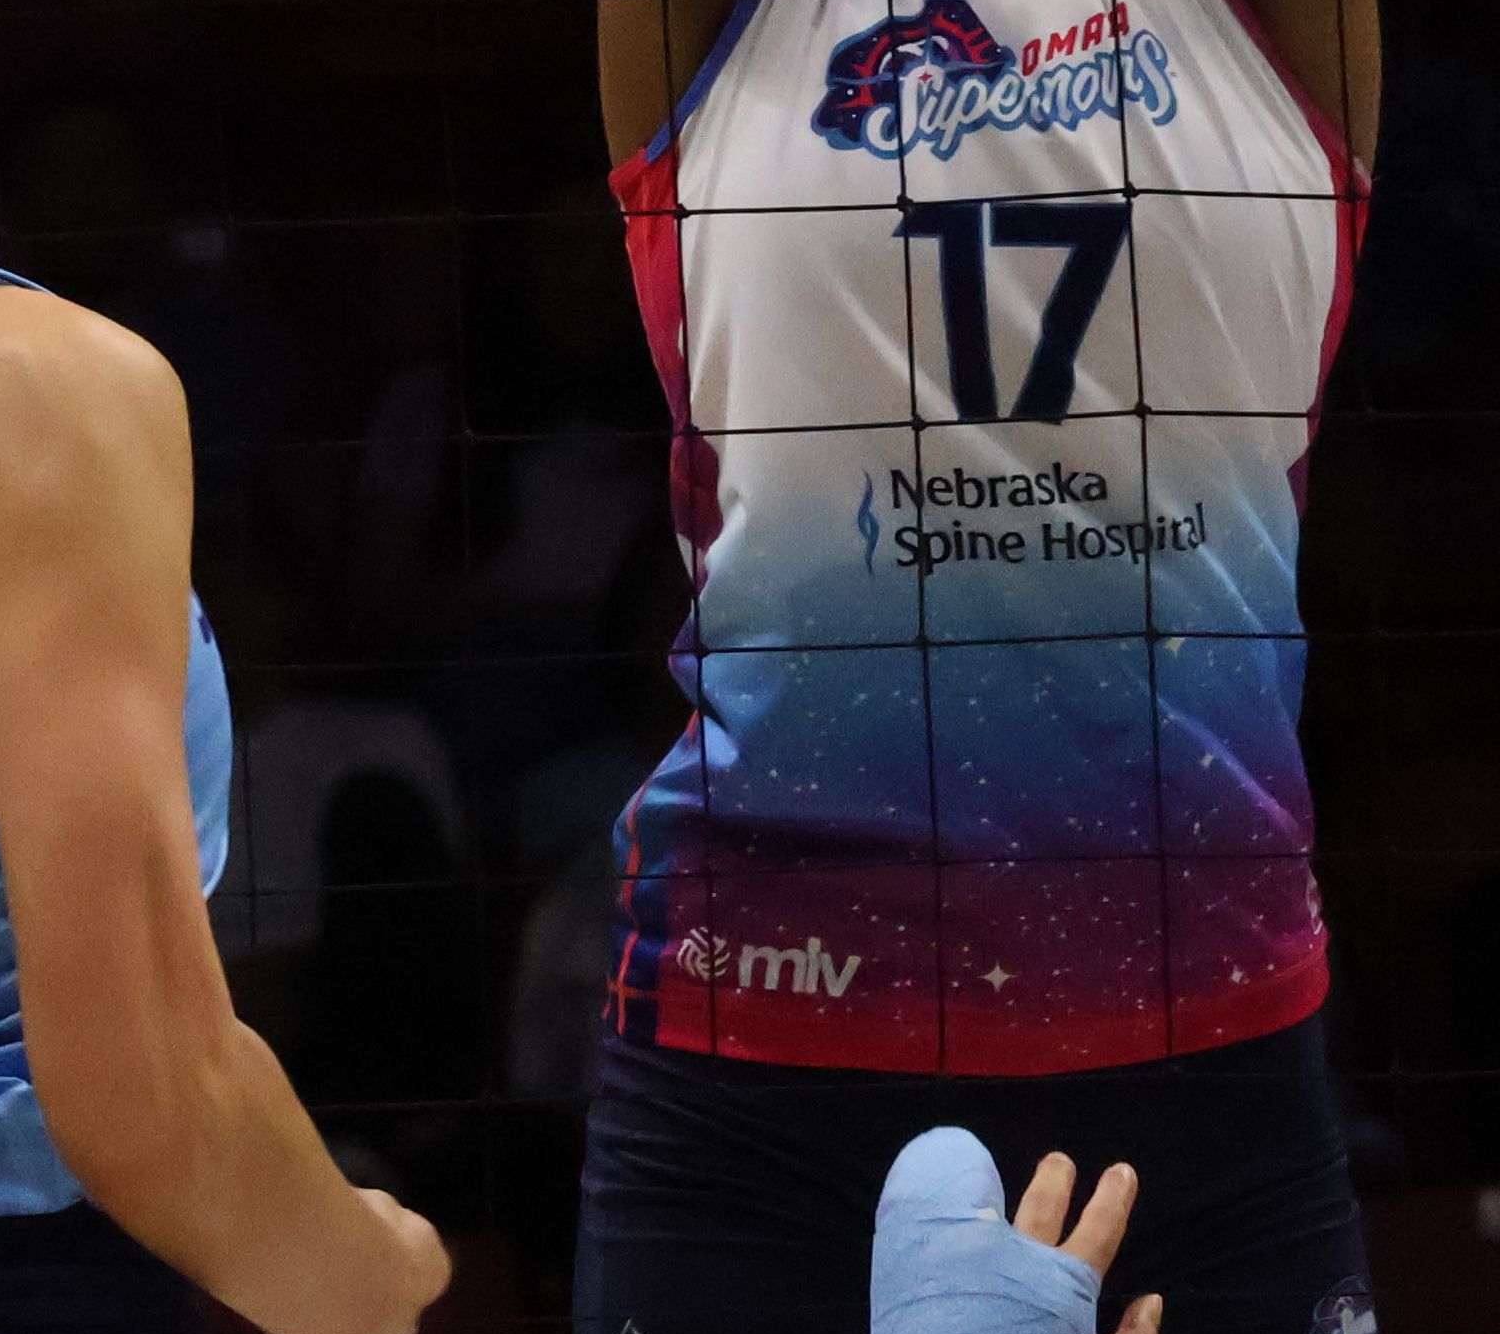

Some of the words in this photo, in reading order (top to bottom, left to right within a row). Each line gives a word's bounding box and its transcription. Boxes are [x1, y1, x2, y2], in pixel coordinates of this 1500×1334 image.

[891, 201, 1133, 425] 17
[890, 461, 1108, 511] Nebraska
[893, 519, 1026, 577] Spine
[1041, 501, 1208, 566] Hospital
[738, 936, 863, 998] mlv
